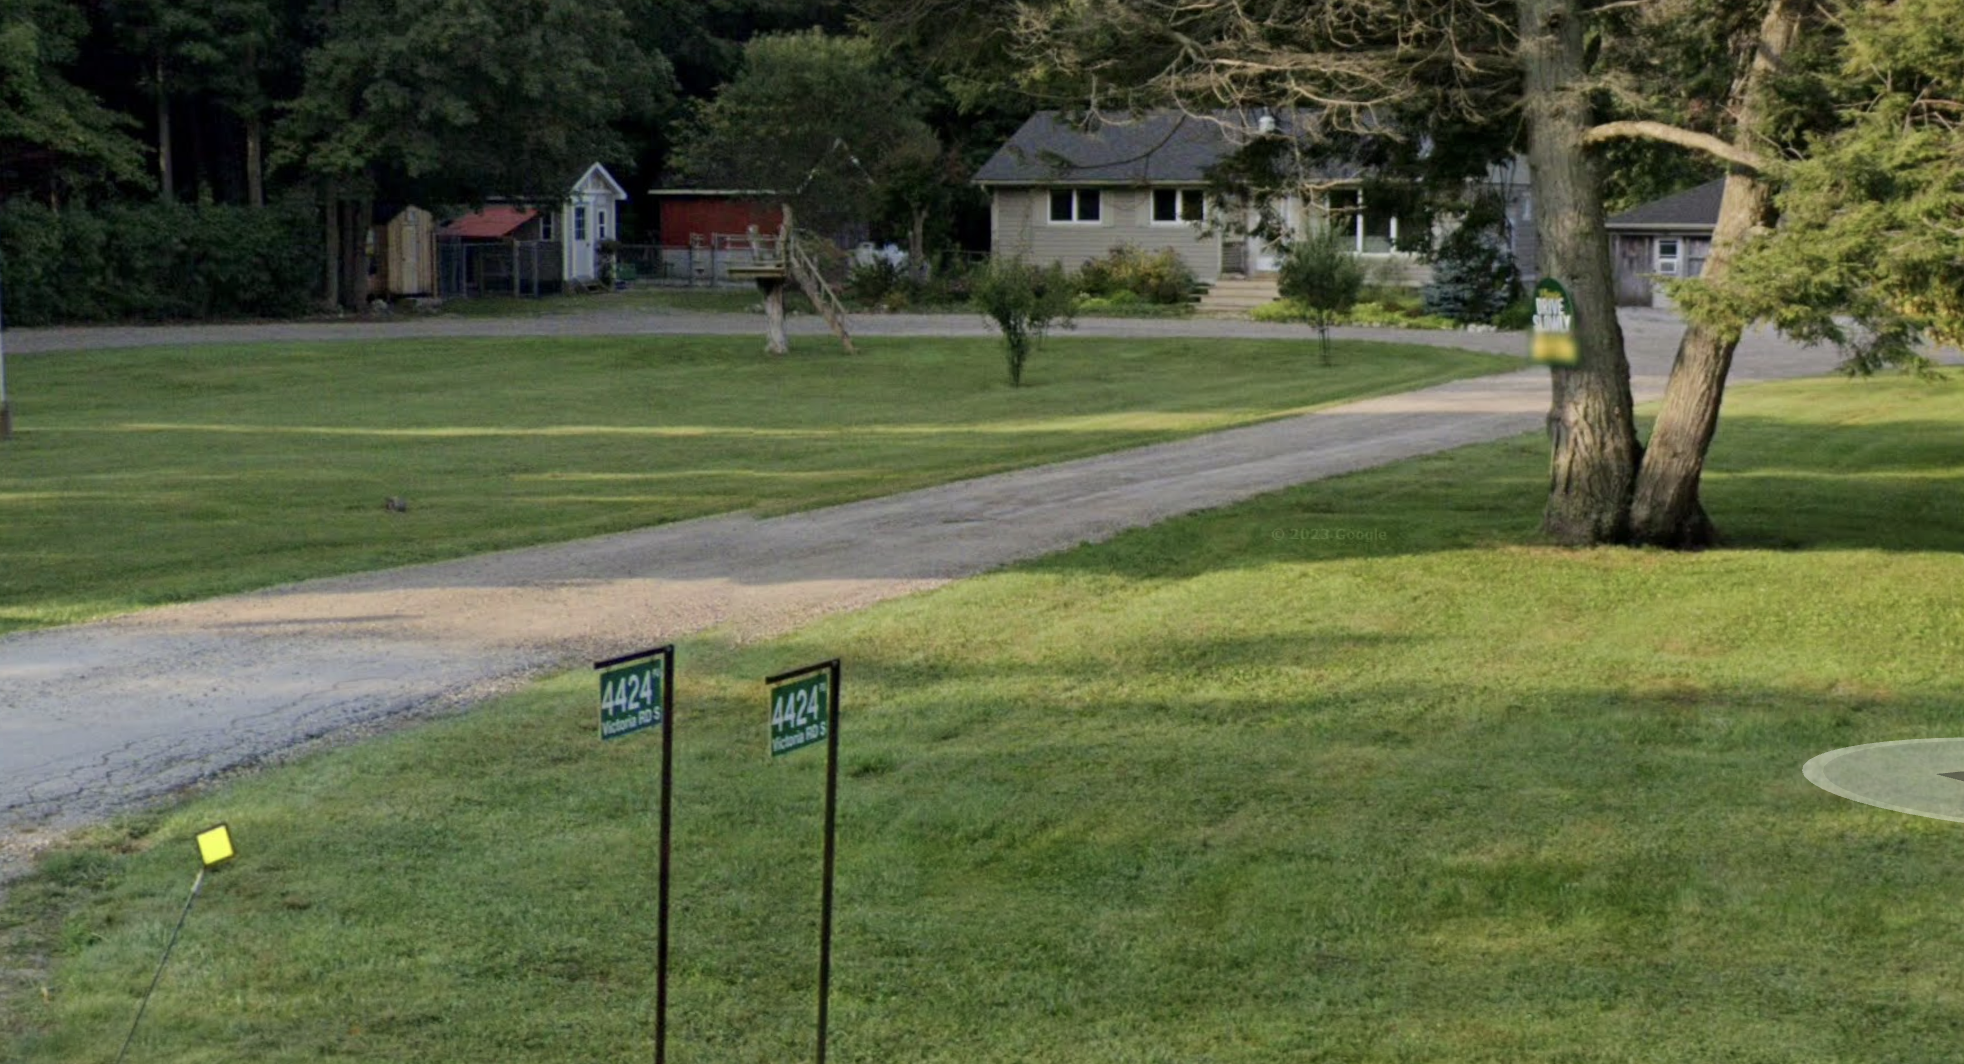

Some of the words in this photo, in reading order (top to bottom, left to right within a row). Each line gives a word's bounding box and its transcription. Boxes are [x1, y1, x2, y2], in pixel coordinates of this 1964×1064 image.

[601, 669, 653, 717] 4424
[771, 684, 819, 732] 4424
[602, 714, 638, 736] Victoria
[638, 708, 653, 725] RD
[652, 705, 661, 720] S
[773, 729, 805, 752] Victoria
[805, 723, 819, 741] RD
[819, 721, 827, 736] S
